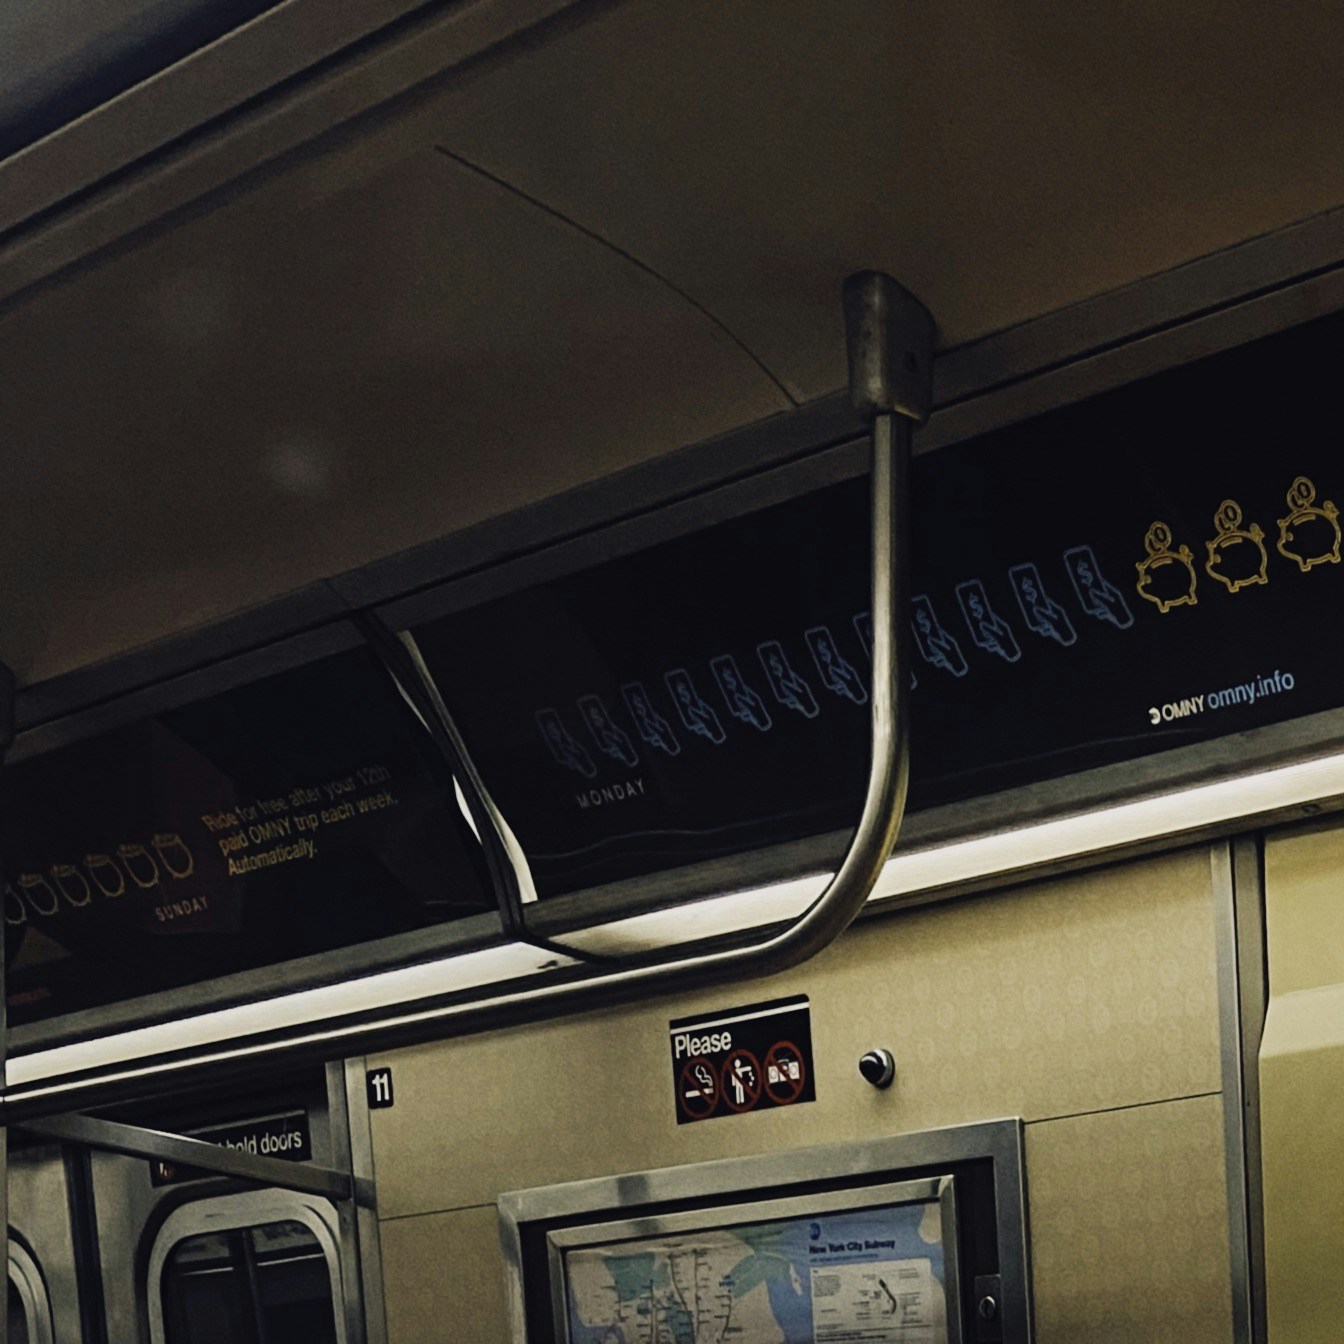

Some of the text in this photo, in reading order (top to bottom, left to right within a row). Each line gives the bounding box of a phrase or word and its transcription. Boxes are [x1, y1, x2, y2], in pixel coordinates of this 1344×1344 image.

[1162, 669, 1295, 721] OMNY omny.info
[201, 810, 238, 832] Ride
[235, 805, 257, 822] for
[288, 787, 321, 807] after
[323, 776, 356, 799] your
[576, 778, 646, 808] MONDAY
[218, 791, 399, 856] paid OMNY trip each week.
[228, 838, 318, 876] Automatically.
[154, 895, 208, 922] SUNDAY
[673, 1029, 732, 1059] Please
[371, 1073, 391, 1102] 11
[226, 1131, 302, 1155] hold doors
